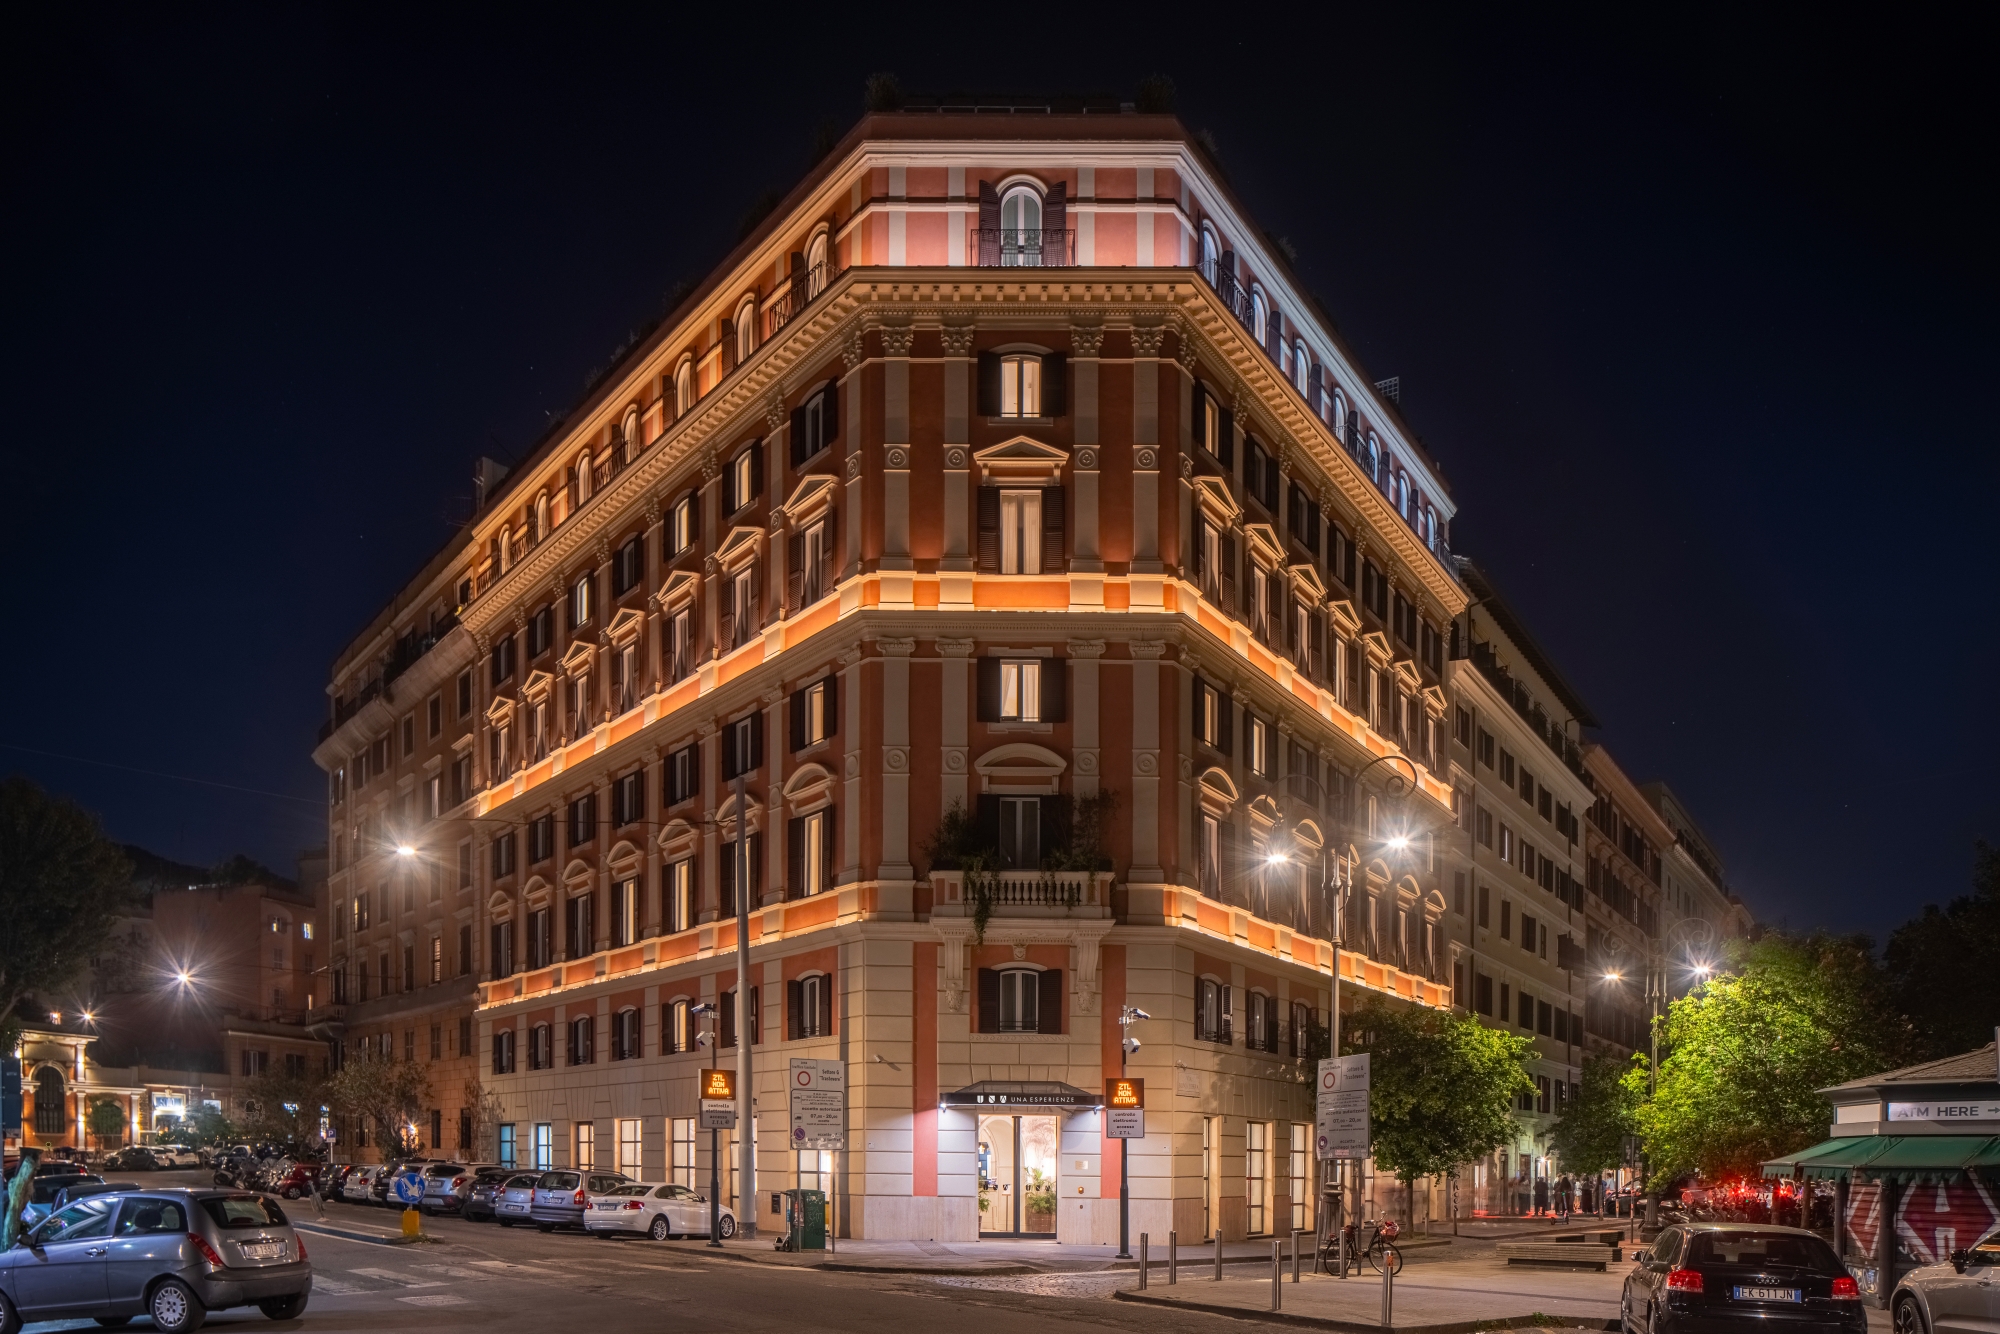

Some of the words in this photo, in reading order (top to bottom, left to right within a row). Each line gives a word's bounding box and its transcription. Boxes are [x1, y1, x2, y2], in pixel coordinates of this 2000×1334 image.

[708, 1087, 730, 1095] ATTIVA
[1897, 1107, 1929, 1118] ATM
[1937, 1106, 1979, 1117] HERE
